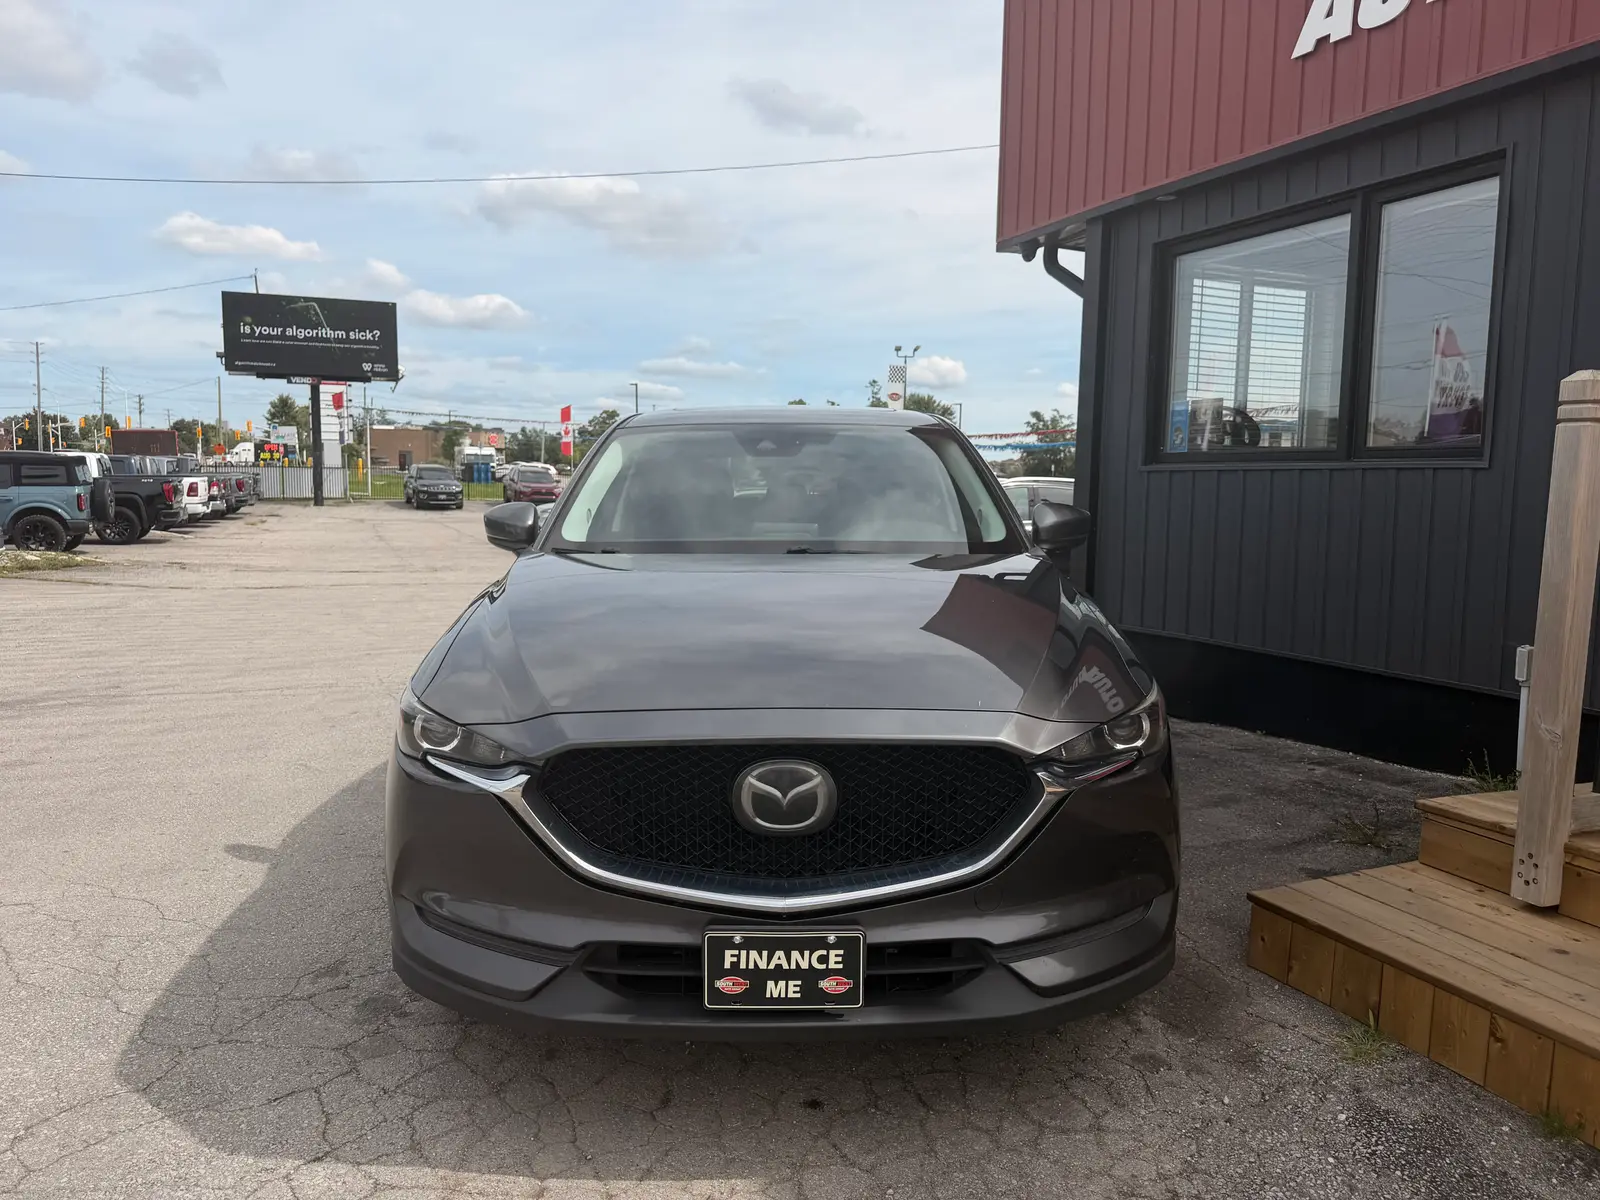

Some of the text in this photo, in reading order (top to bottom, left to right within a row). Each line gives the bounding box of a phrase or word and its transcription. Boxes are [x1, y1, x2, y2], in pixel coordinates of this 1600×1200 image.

[240, 322, 380, 341] is your algorithm sick?
[263, 443, 279, 451] OPEN
[723, 949, 844, 970] FINANCE
[765, 980, 802, 998] ME
